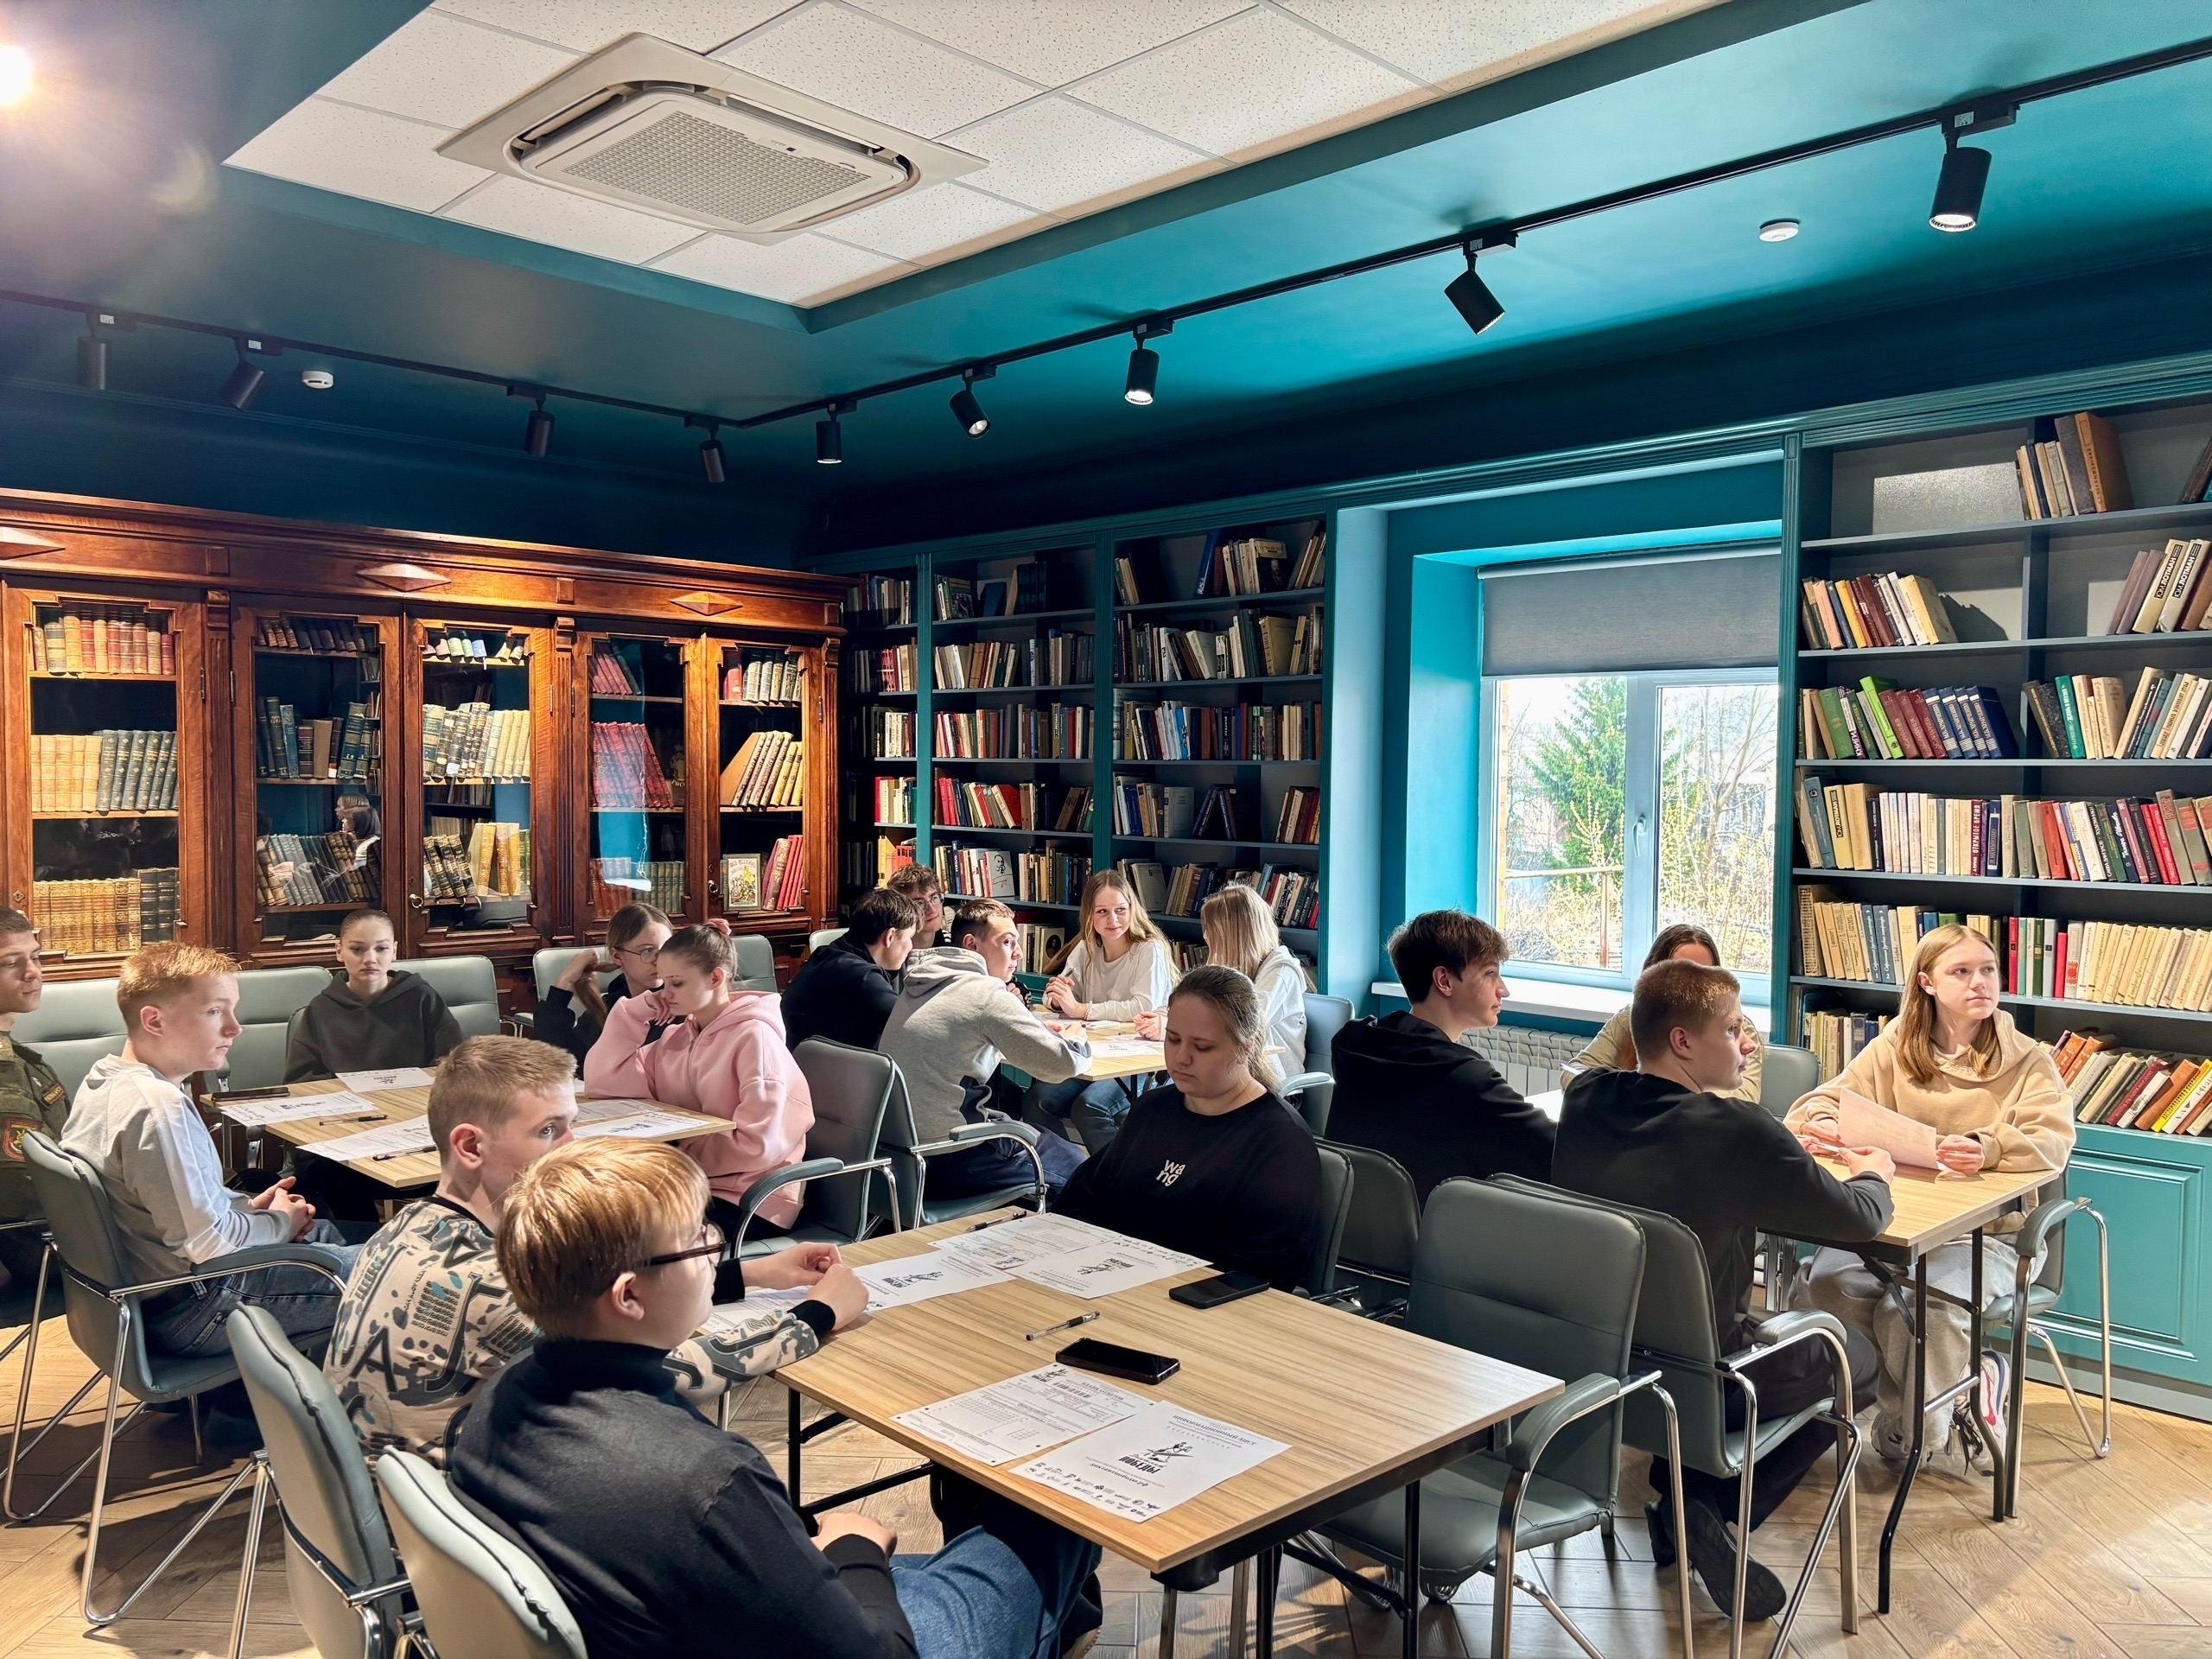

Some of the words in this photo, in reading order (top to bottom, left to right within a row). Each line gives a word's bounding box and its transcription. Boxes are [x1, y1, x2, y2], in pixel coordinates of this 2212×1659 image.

[2159, 556, 2177, 586] ЛОТМАН
[2178, 555, 2196, 586] ЛОТМАН
[1118, 1454, 1161, 1474] ПОБЕДЫ
